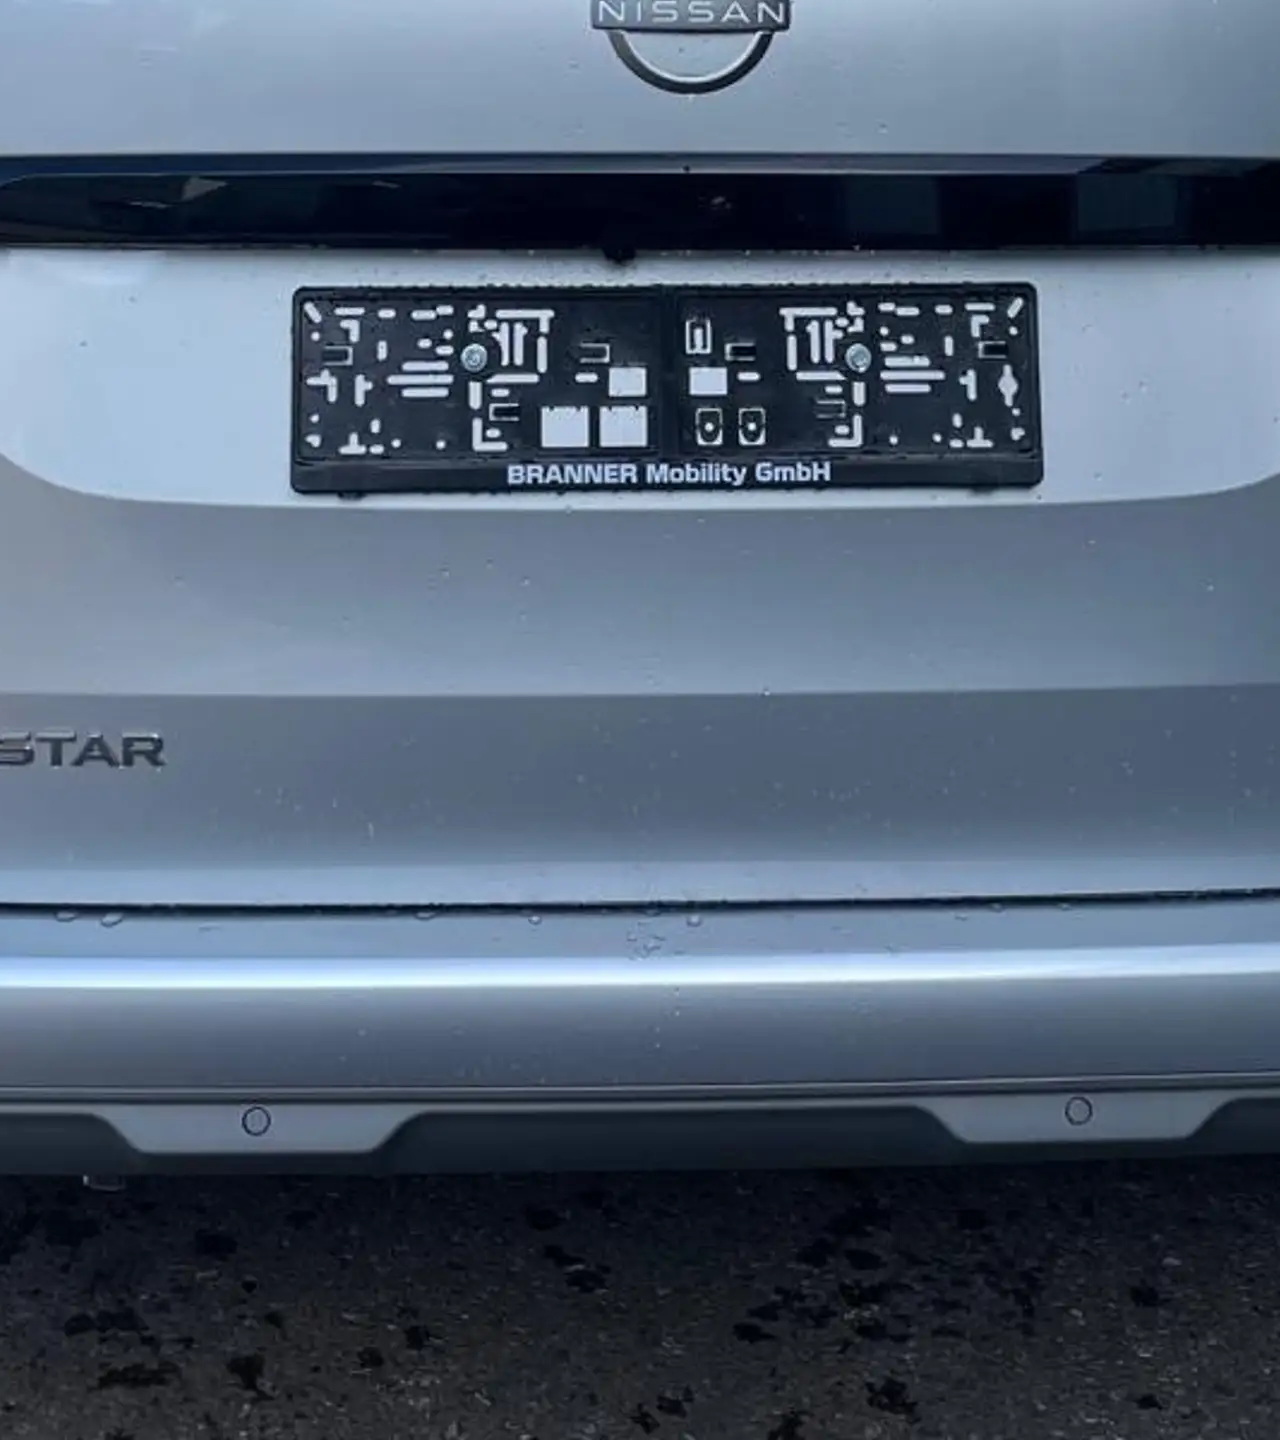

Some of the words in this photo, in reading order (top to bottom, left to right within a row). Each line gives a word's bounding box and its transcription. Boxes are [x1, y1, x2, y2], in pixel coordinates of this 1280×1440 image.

[598, 0, 785, 24] NISSAN
[507, 463, 638, 485] BRANNER
[646, 462, 746, 486] Mobility
[755, 461, 831, 482] GmbH
